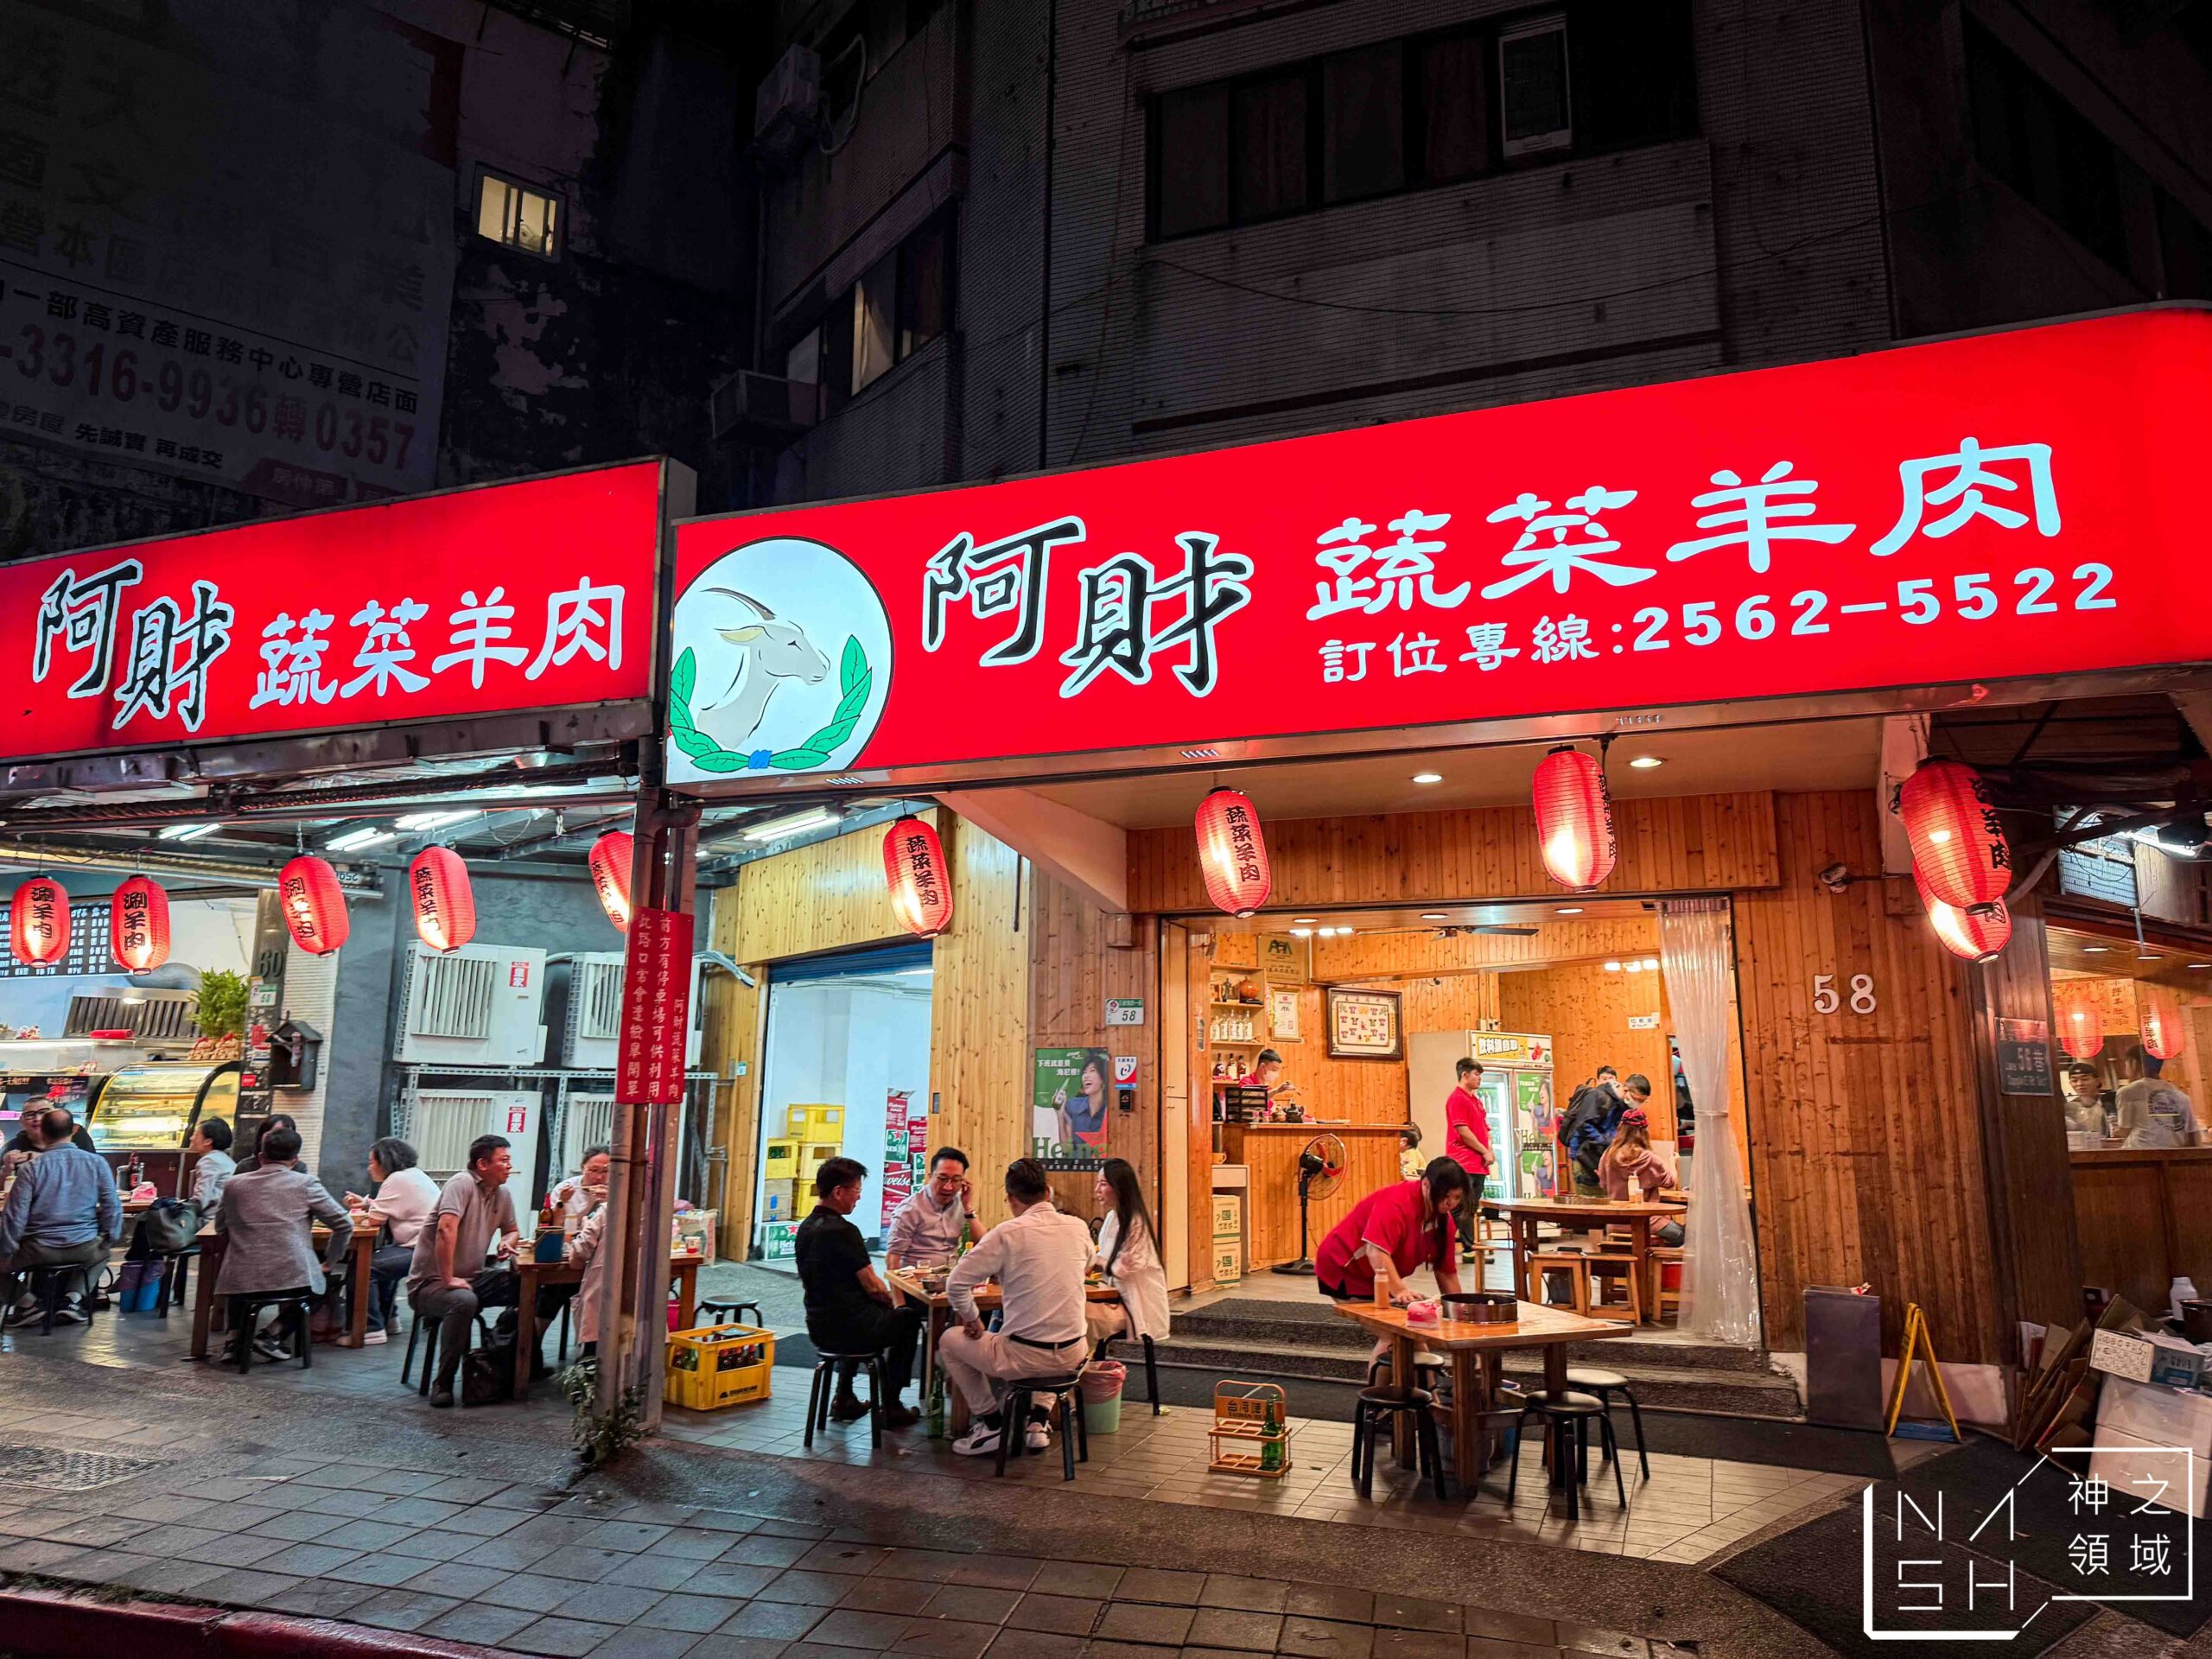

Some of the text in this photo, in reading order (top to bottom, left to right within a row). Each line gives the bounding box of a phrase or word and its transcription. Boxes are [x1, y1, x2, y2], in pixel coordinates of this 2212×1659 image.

[75, 423, 146, 452] 先誠實
[156, 439, 223, 468] 再成交
[922, 437, 2061, 698] 阿財 蔬菜羊肉
[33, 559, 625, 732] 阿財 蔬菜羊肉
[906, 835, 938, 907] 蔬菜羊肉
[1224, 805, 1261, 881] 蔬菜羊肉
[259, 951, 283, 977] 60
[1122, 1010, 1136, 1021] 58
[1815, 975, 1876, 1014] 58
